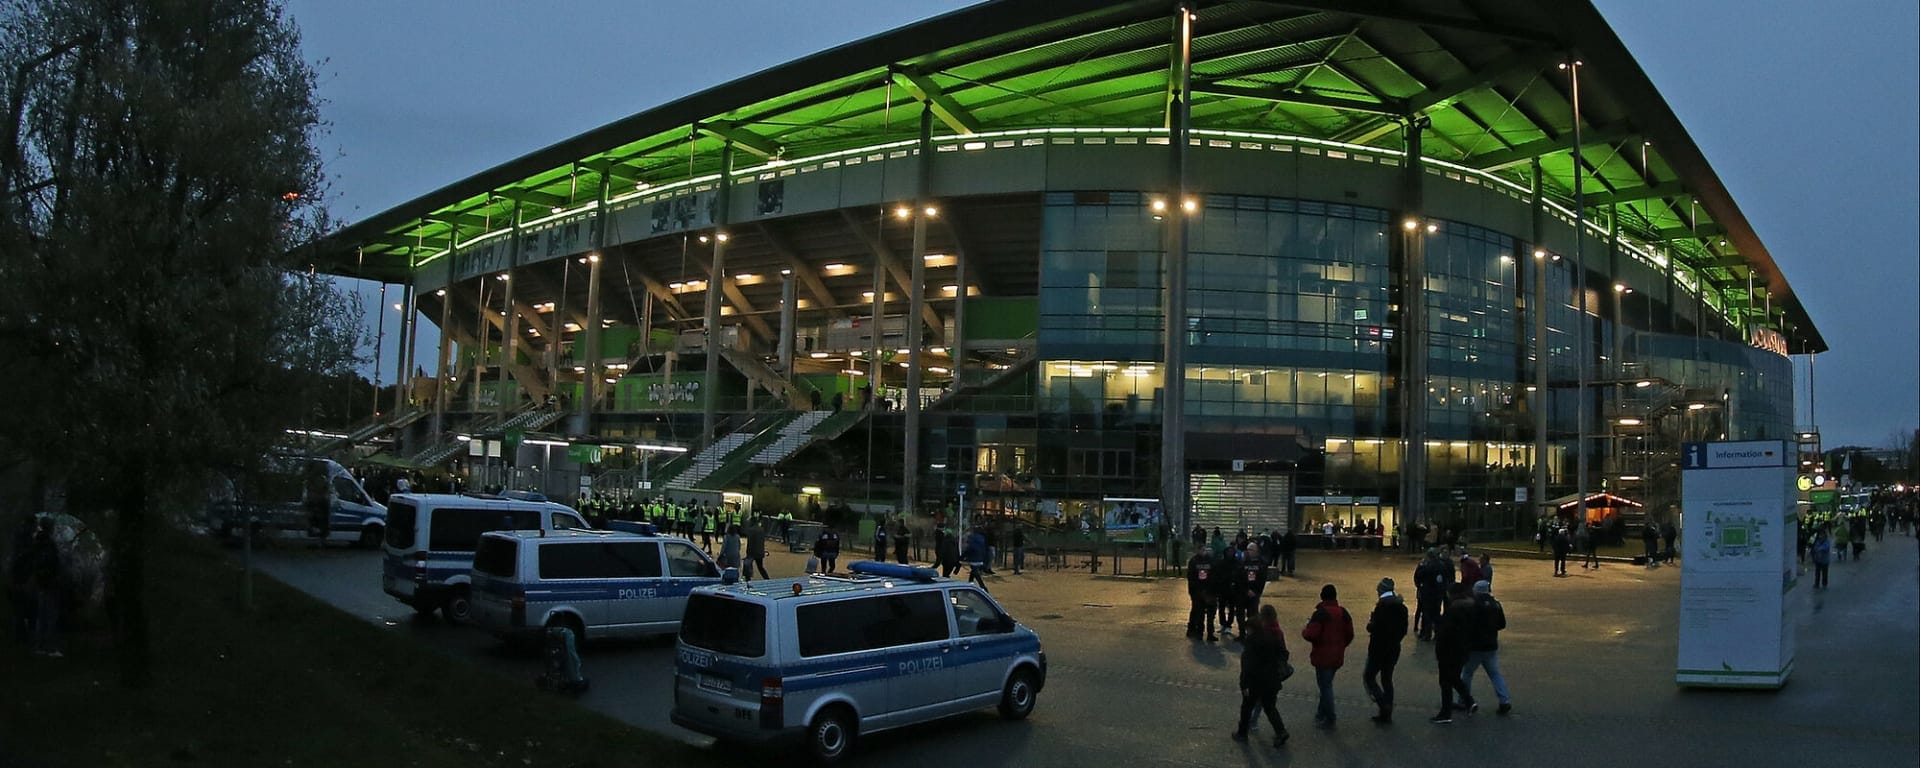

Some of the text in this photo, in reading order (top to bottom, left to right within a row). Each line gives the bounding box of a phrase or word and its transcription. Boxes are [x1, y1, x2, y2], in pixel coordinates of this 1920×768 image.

[1716, 450, 1762, 459] Information
[618, 587, 657, 599] POLIZEI
[898, 655, 944, 675] POLIZEI
